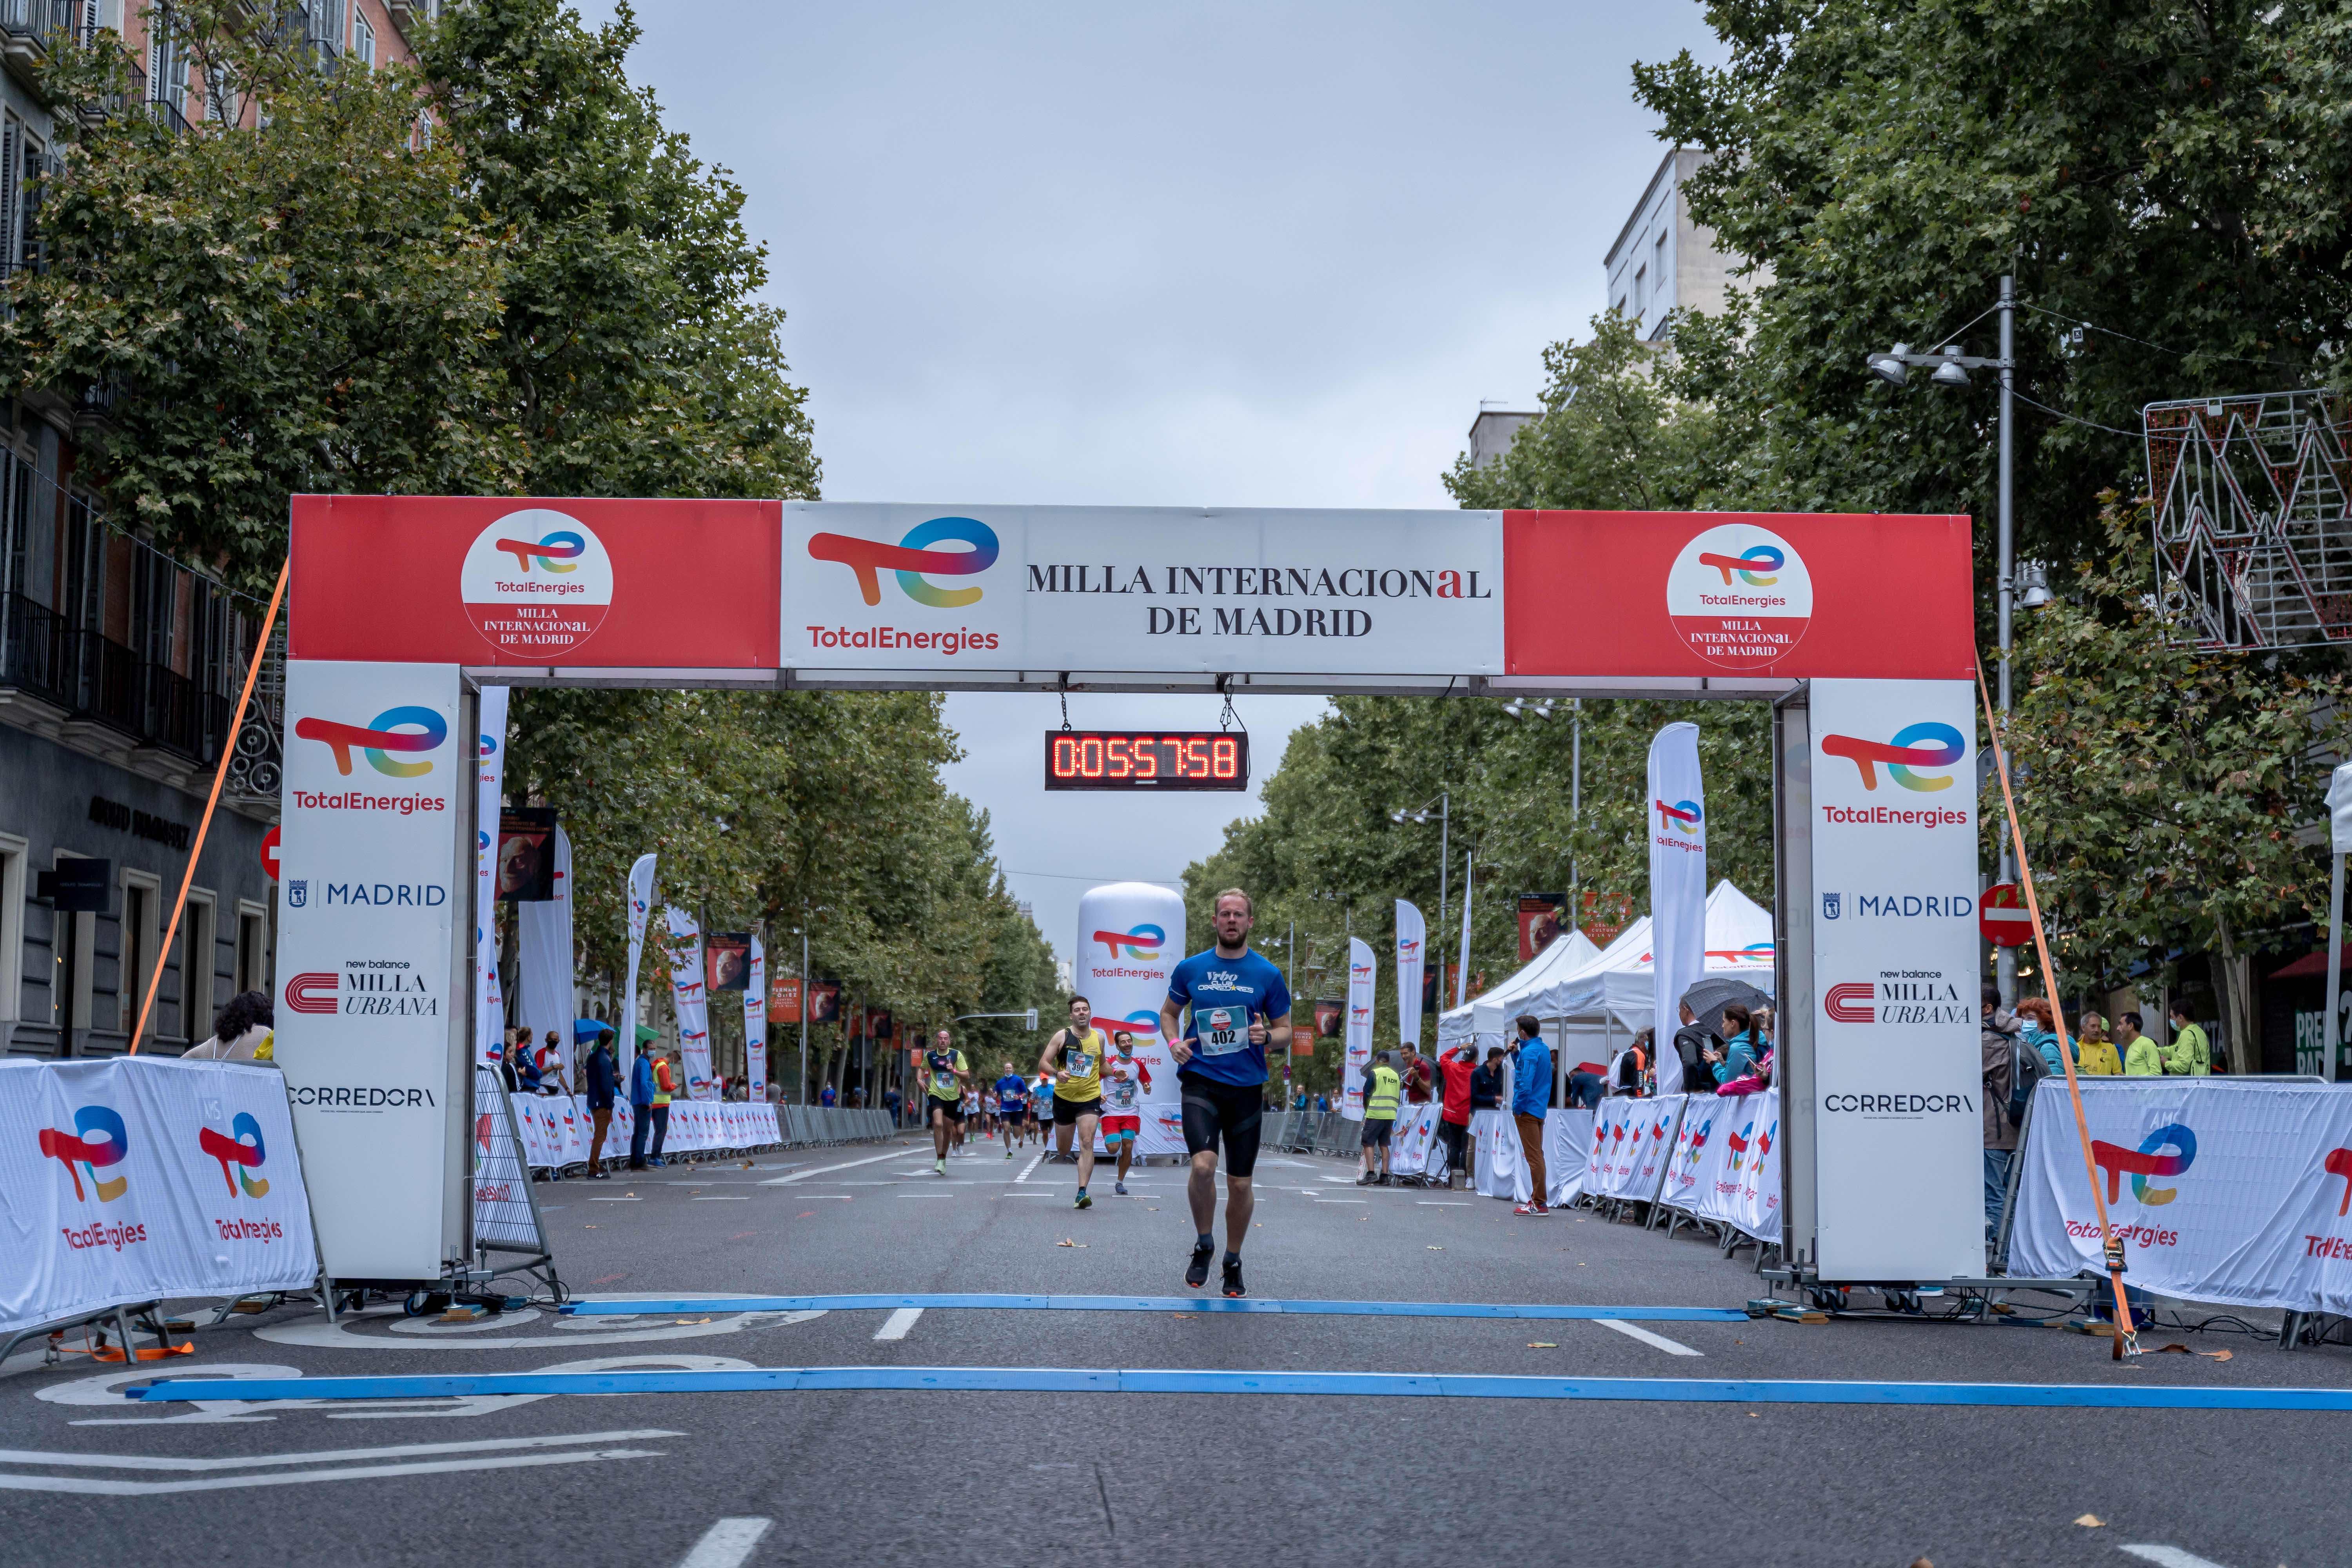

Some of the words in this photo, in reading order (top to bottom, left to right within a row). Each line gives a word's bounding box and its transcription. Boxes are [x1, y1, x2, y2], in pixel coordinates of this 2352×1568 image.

[1026, 564, 1157, 594] MILLA
[495, 582, 584, 595] TotalEnergies
[1700, 595, 1786, 608] TotalEnergies
[517, 608, 558, 618] MILLA
[1146, 606, 1201, 635] DE
[1212, 608, 1372, 637] MADRID
[1722, 621, 1762, 630] MILLA
[500, 634, 518, 644] DE
[521, 635, 573, 644] MADRID
[806, 626, 999, 655] TotalEnergies
[1707, 646, 1724, 656] DE
[1728, 646, 1777, 656] MADRID
[292, 791, 445, 815] TotalEnergies
[1822, 806, 1967, 828] TotalEnergies
[327, 883, 445, 906] MADRID
[1860, 896, 1972, 917] MADRID
[368, 960, 410, 969] balance
[1092, 968, 1164, 980] TotalEnergies
[1207, 971, 1238, 981] Vrbo
[1902, 970, 1942, 979] balance
[345, 973, 428, 992] MILLA
[1881, 983, 1960, 1000] MILLA
[345, 996, 438, 1016] URBANA
[1882, 1006, 1972, 1024] URBANA
[1211, 1030, 1236, 1045] 402
[1072, 1063, 1085, 1072] 390
